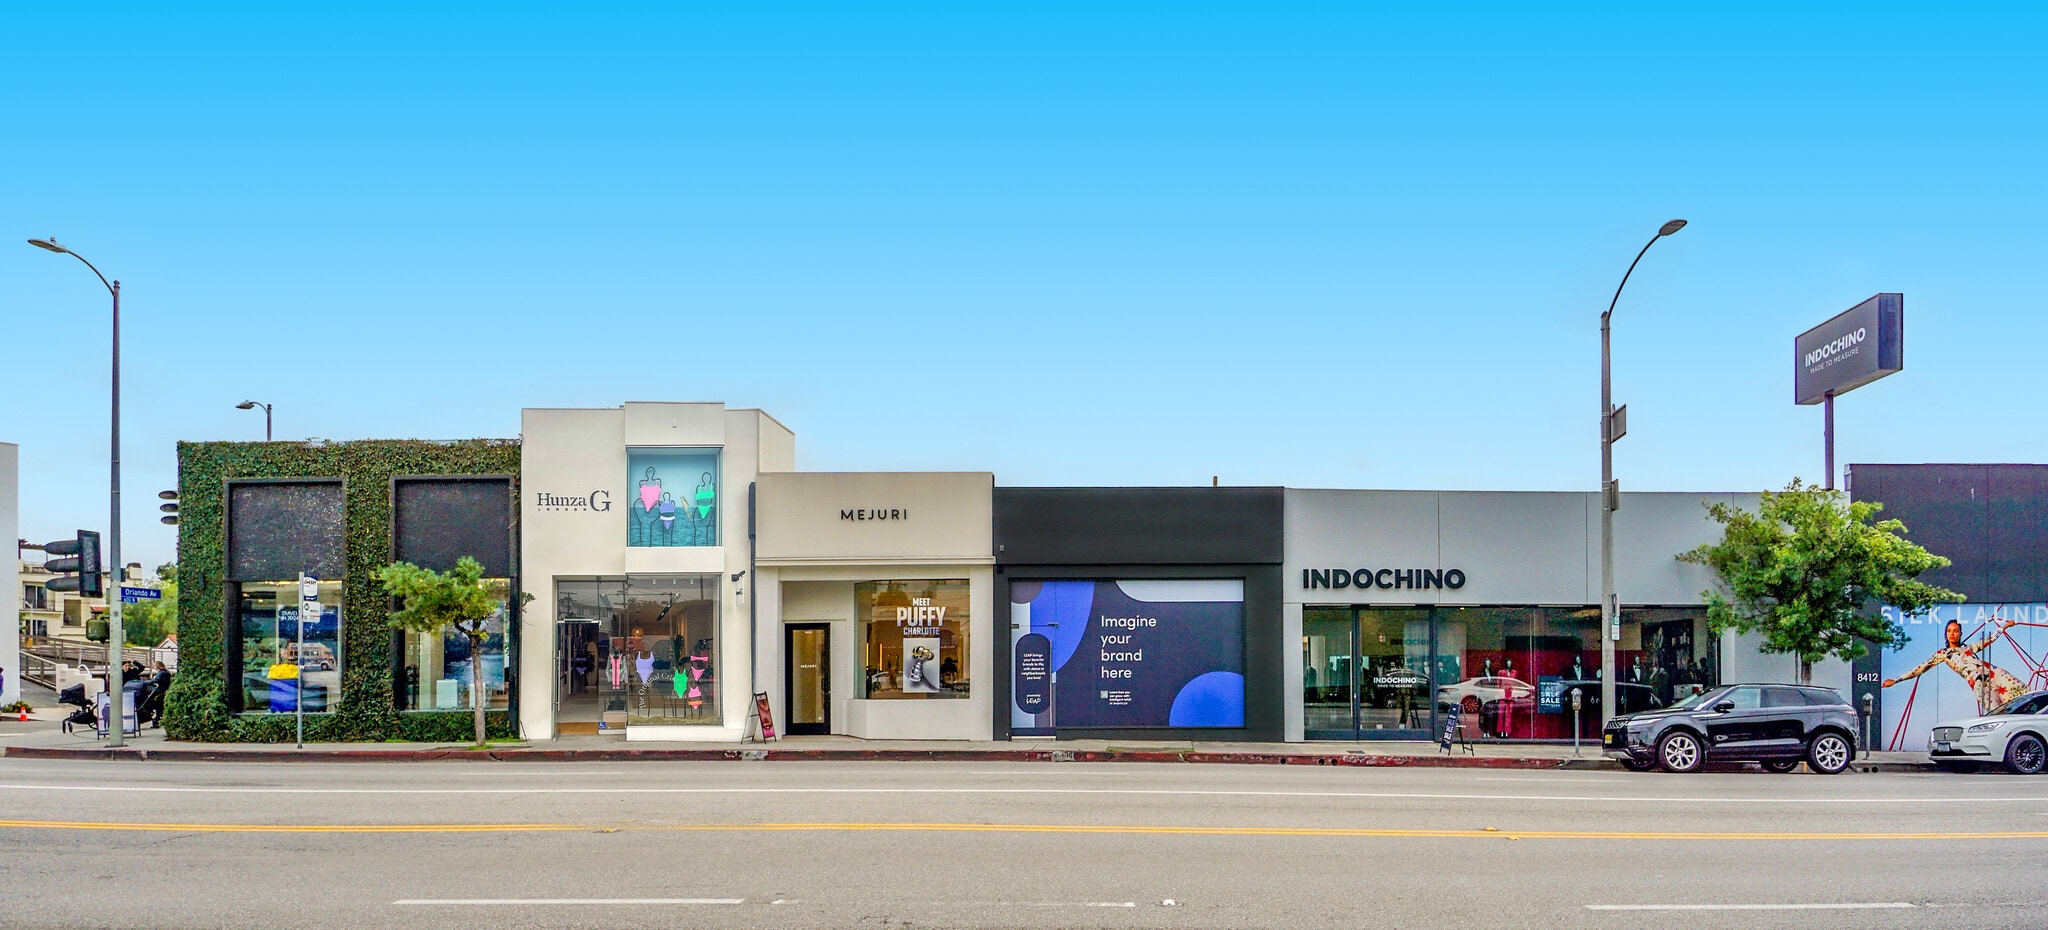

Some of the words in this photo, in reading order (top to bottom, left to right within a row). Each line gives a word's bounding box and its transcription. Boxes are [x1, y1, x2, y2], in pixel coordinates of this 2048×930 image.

[1805, 327, 1866, 367] INDOCHINO
[1809, 362, 1825, 375] MADE
[1826, 359, 1833, 367] TO
[1834, 346, 1859, 364] MEASURE
[536, 492, 588, 507] Hunza
[589, 489, 612, 512] G
[840, 508, 907, 522] MEJURI
[1302, 568, 1466, 590] INDOCHINO
[125, 588, 149, 597] Orlando
[149, 590, 157, 598] Av
[912, 597, 931, 607] MEET
[896, 606, 947, 627] PUFFY
[1101, 614, 1157, 631] Imagine
[903, 626, 940, 636] CHARLOTTE
[1100, 635, 1132, 648] your
[1101, 648, 1143, 662] brand
[1101, 665, 1132, 679] here
[1857, 673, 1878, 682] 8412
[638, 672, 660, 695] Original
